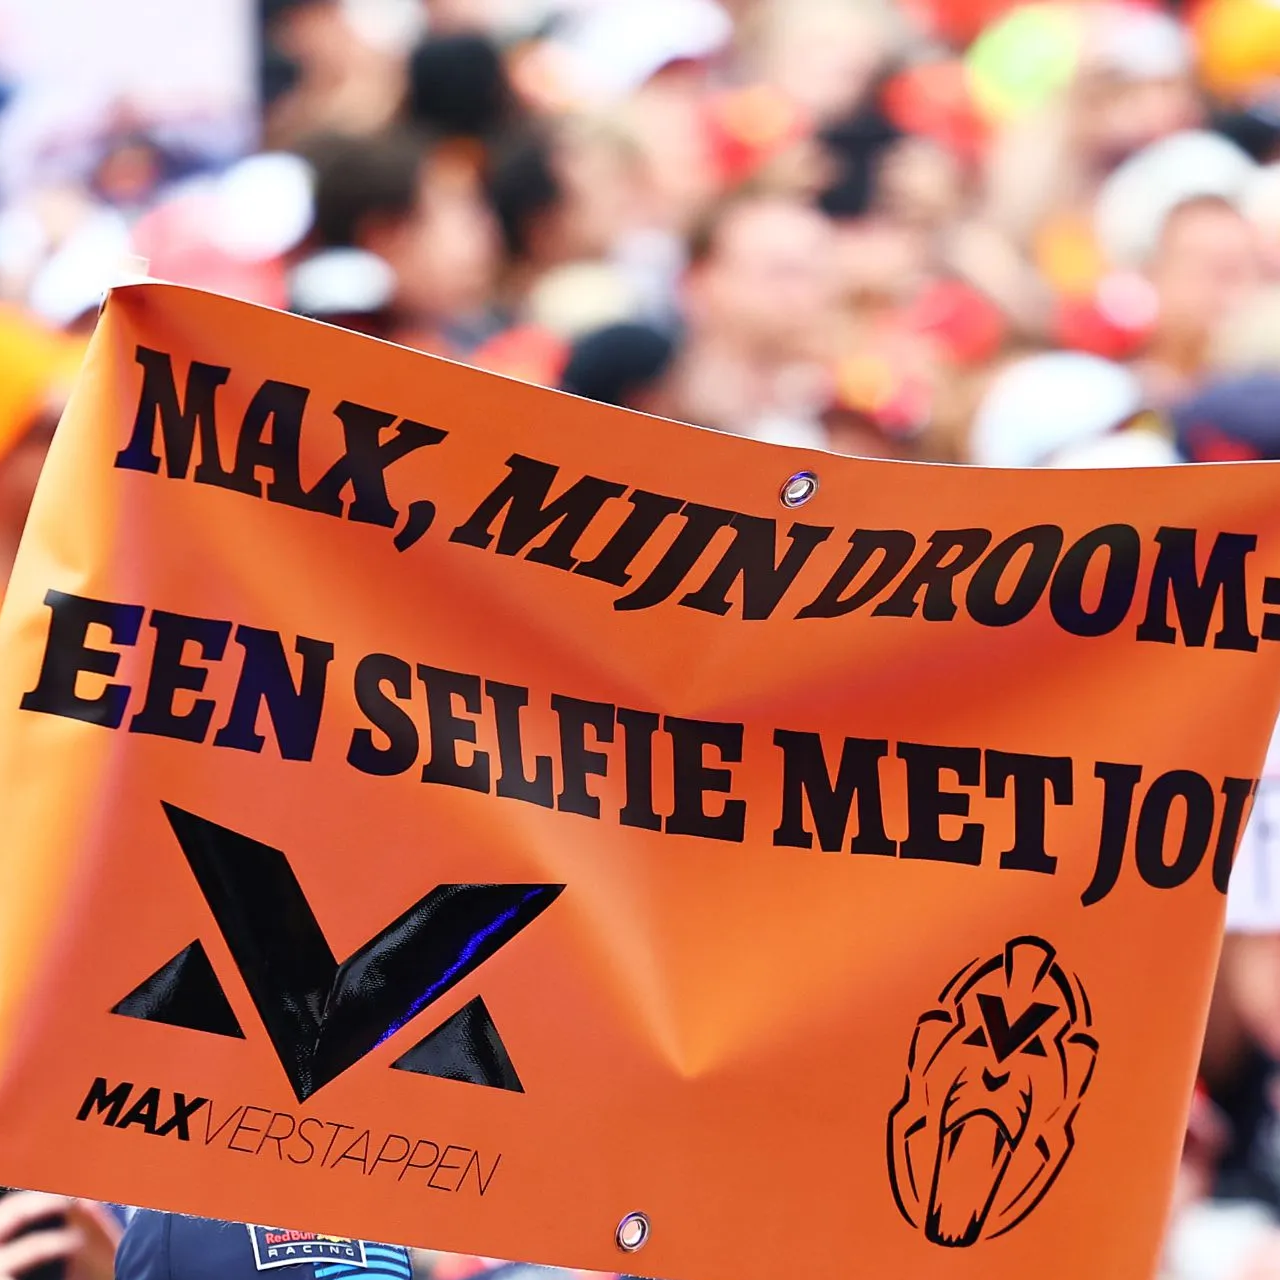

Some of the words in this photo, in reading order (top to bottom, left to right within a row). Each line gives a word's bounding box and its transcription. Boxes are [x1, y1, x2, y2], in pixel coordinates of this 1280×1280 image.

[115, 345, 449, 553] MAX,
[448, 453, 827, 620] MIJN
[20, 589, 333, 762] EEN
[346, 652, 747, 843] SELFIE
[773, 728, 1073, 874] MET
[268, 1245, 355, 1258] RACING
